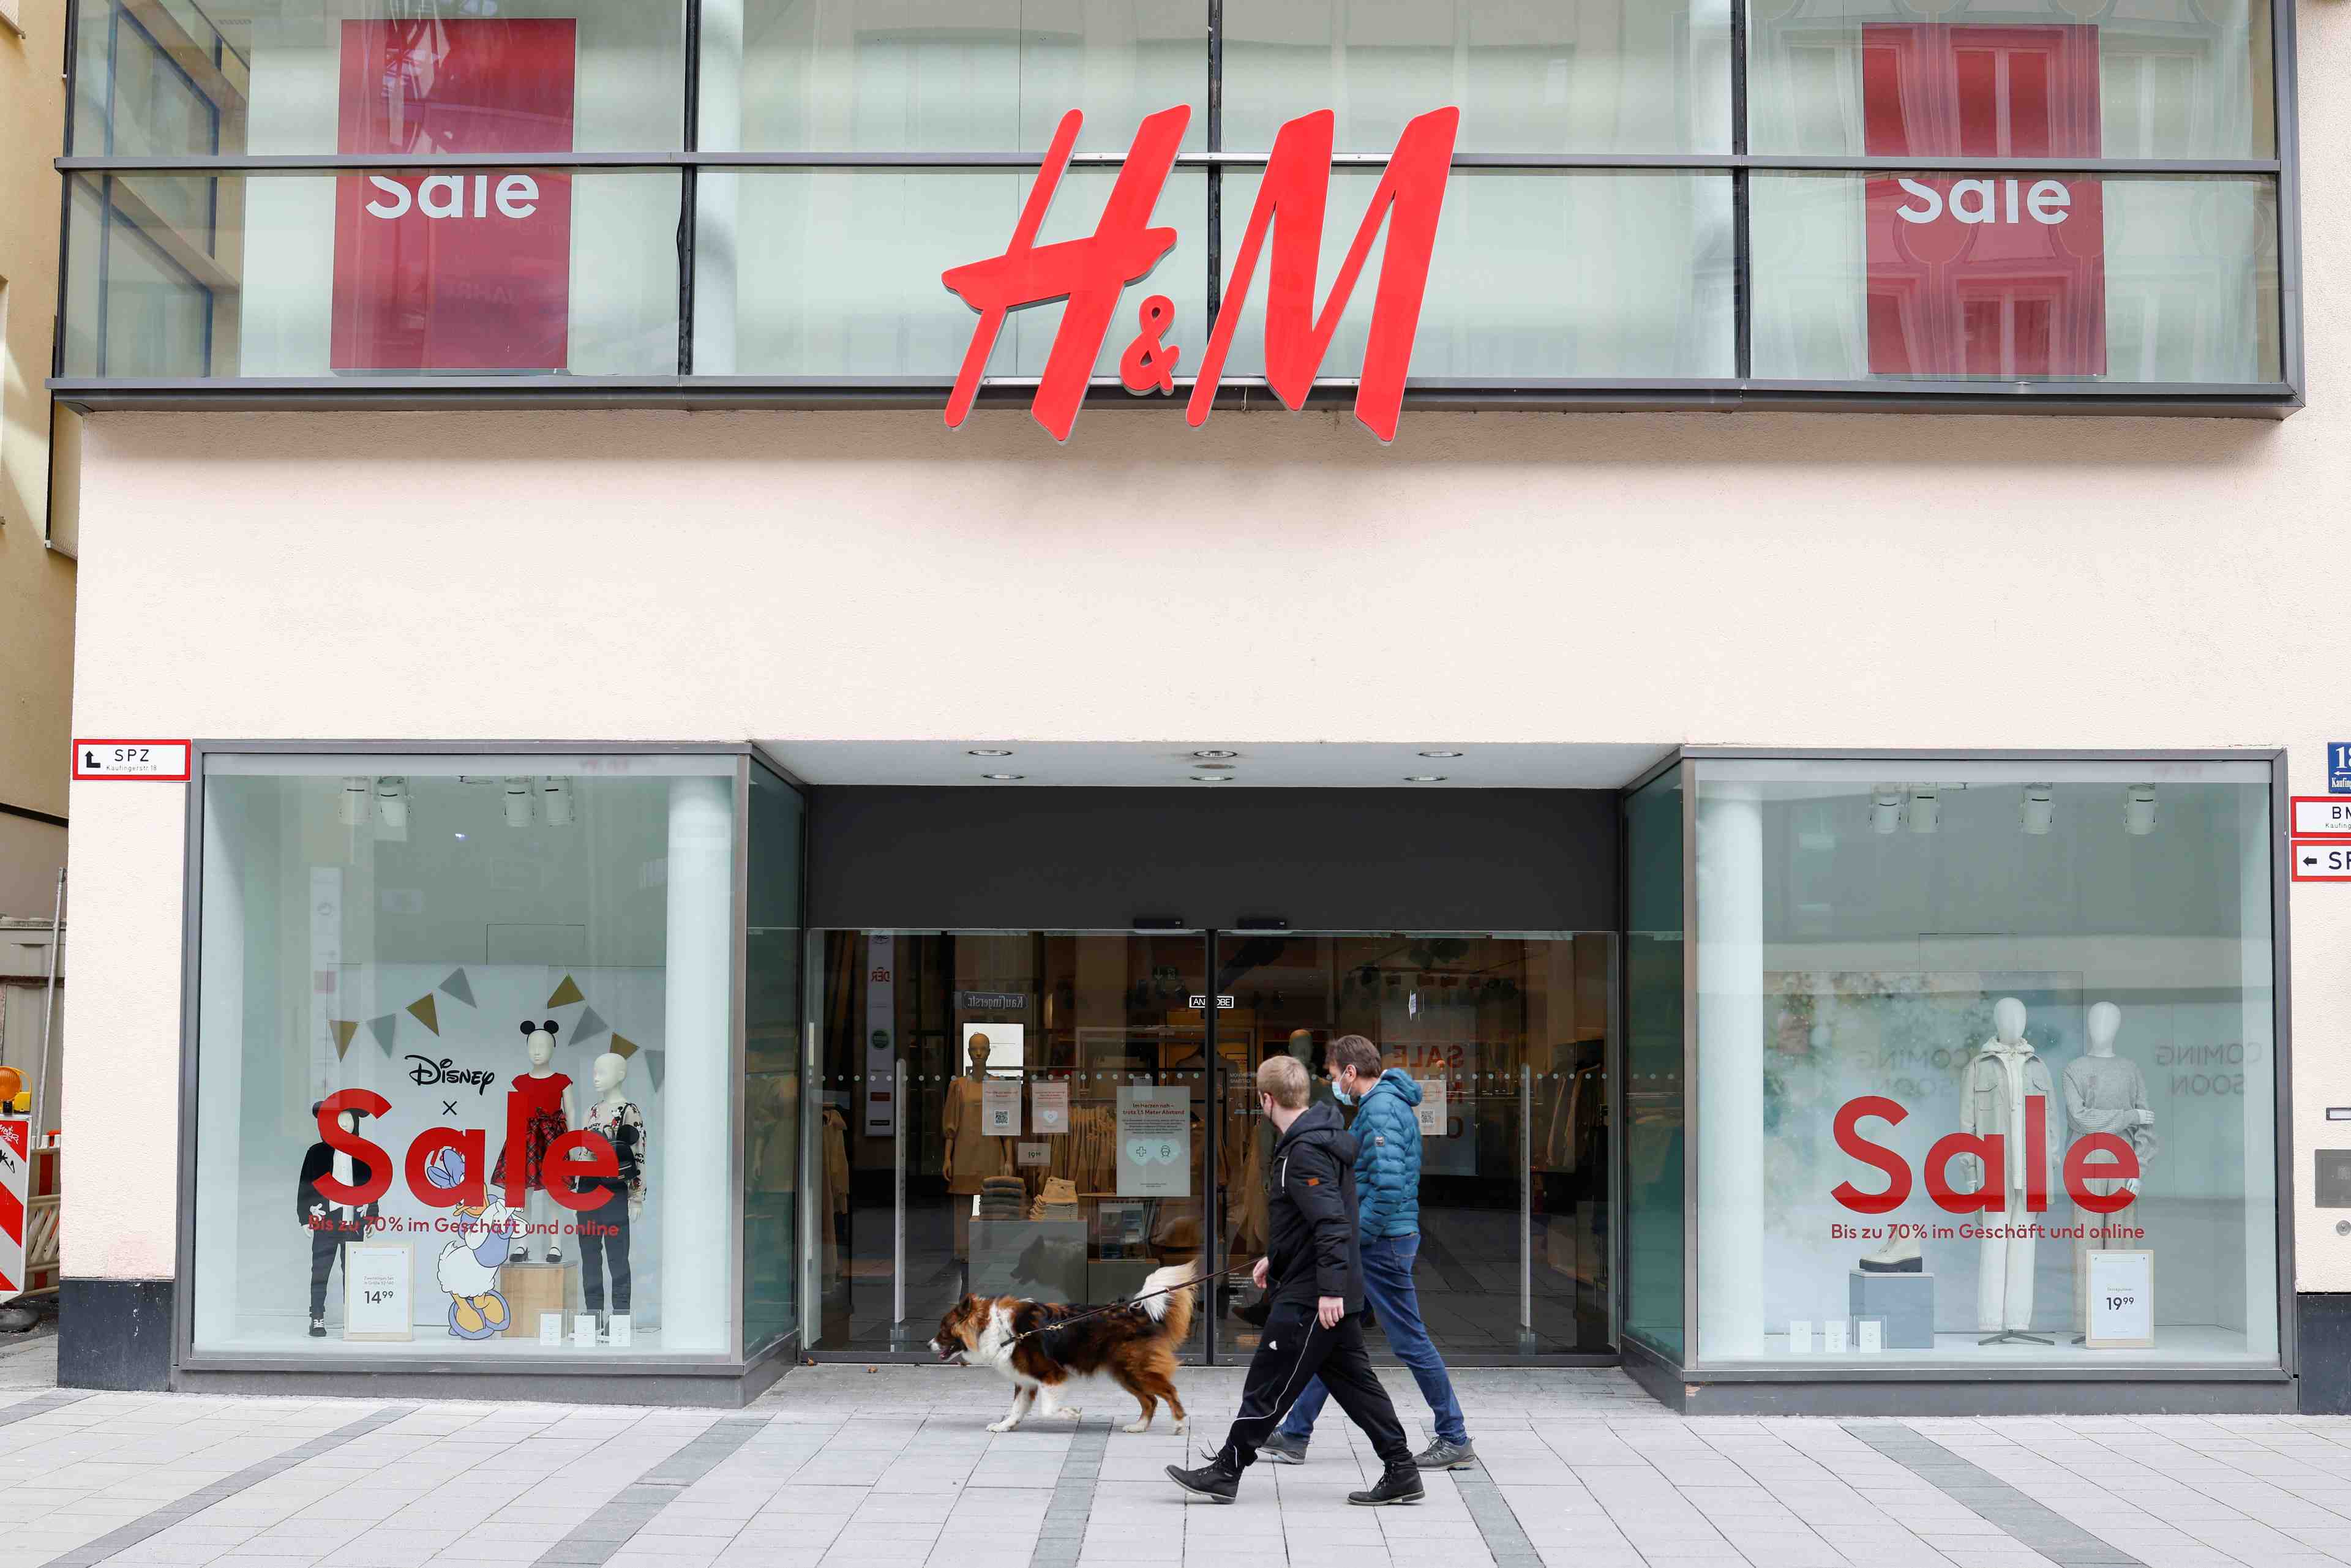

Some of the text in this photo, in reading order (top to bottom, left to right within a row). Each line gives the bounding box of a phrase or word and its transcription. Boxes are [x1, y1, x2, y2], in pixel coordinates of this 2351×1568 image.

[366, 175, 539, 219] Sale
[1896, 178, 2071, 225] Sale
[941, 103, 1461, 445] H&M
[114, 749, 149, 762] SPZ
[2336, 746, 2351, 768] 1
[2331, 777, 2351, 790] Kaufin
[312, 1088, 619, 1211] Sale
[1830, 1095, 2140, 1214] Sale
[362, 1215, 403, 1232] 70%
[408, 1217, 429, 1232] im
[434, 1217, 520, 1234] Geschäft
[525, 1219, 559, 1235] und
[564, 1219, 620, 1237] online
[1831, 1223, 2145, 1239] Bis zu 70% im Geschäft und online
